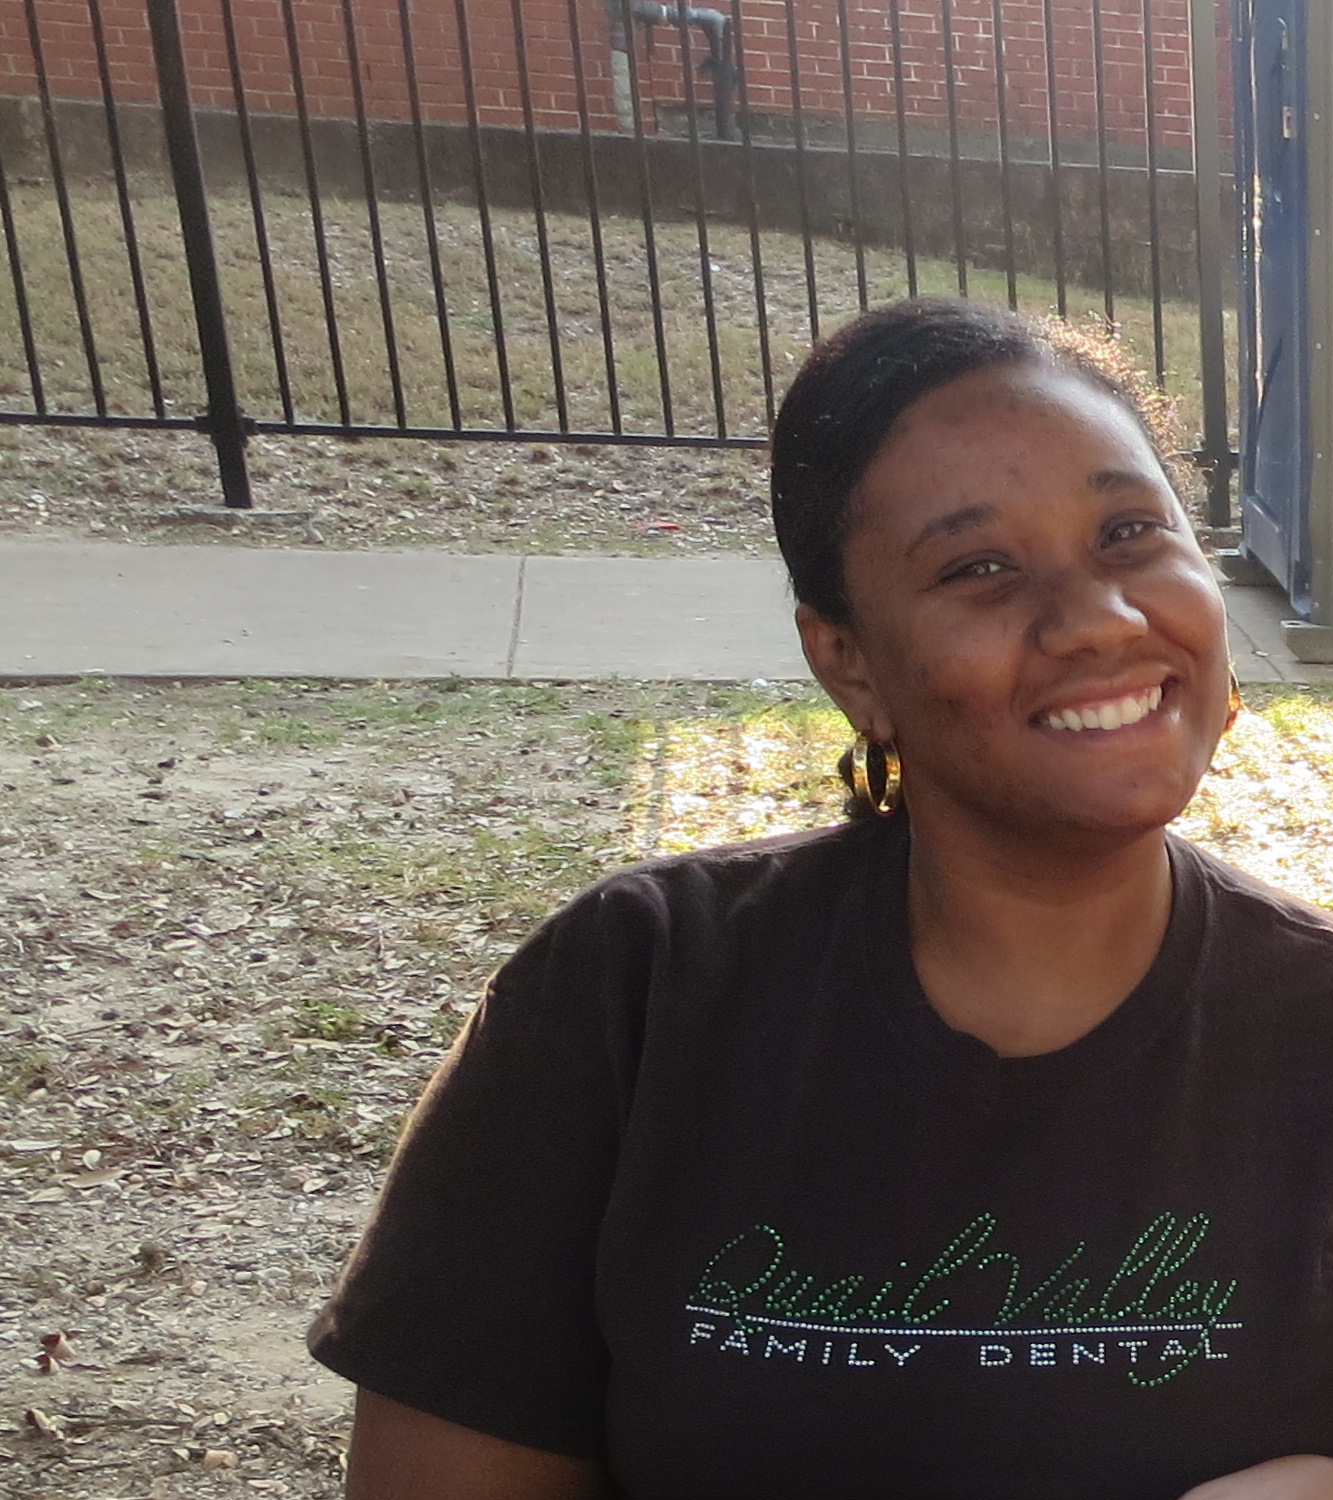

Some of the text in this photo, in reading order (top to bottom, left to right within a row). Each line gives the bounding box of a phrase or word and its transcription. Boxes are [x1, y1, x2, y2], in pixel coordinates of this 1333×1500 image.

[689, 1212, 1238, 1386] Quail Valley
[690, 1322, 1230, 1367] FAMILY DENTAL
